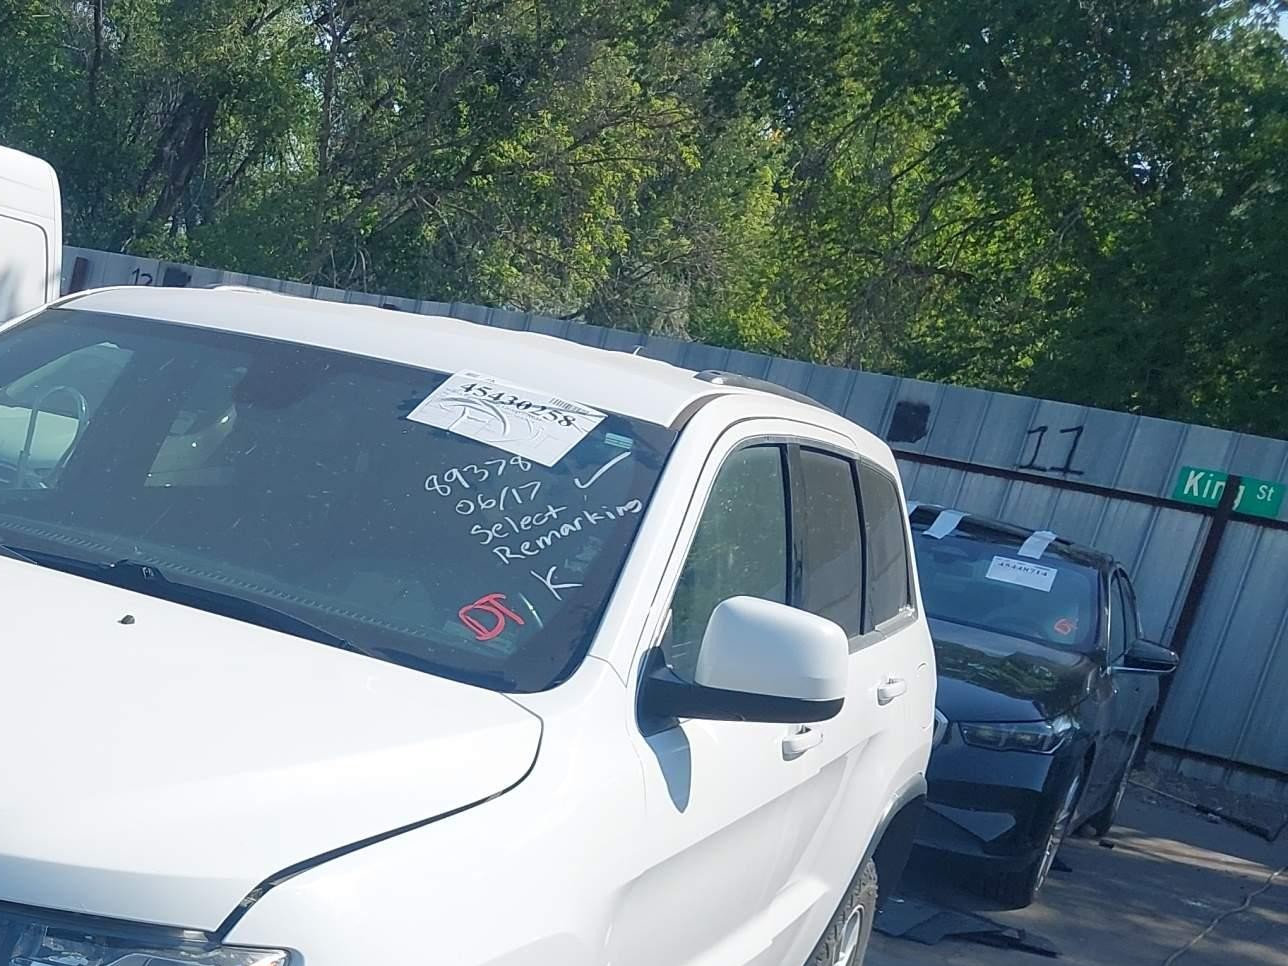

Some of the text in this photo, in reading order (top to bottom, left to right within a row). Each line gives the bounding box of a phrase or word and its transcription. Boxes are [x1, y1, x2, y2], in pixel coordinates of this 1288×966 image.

[460, 382, 577, 427] 45430258
[1018, 425, 1085, 475] 11
[425, 456, 532, 496] 89378
[1256, 484, 1275, 502] St
[455, 481, 542, 515] 06/17
[470, 504, 568, 545] Select
